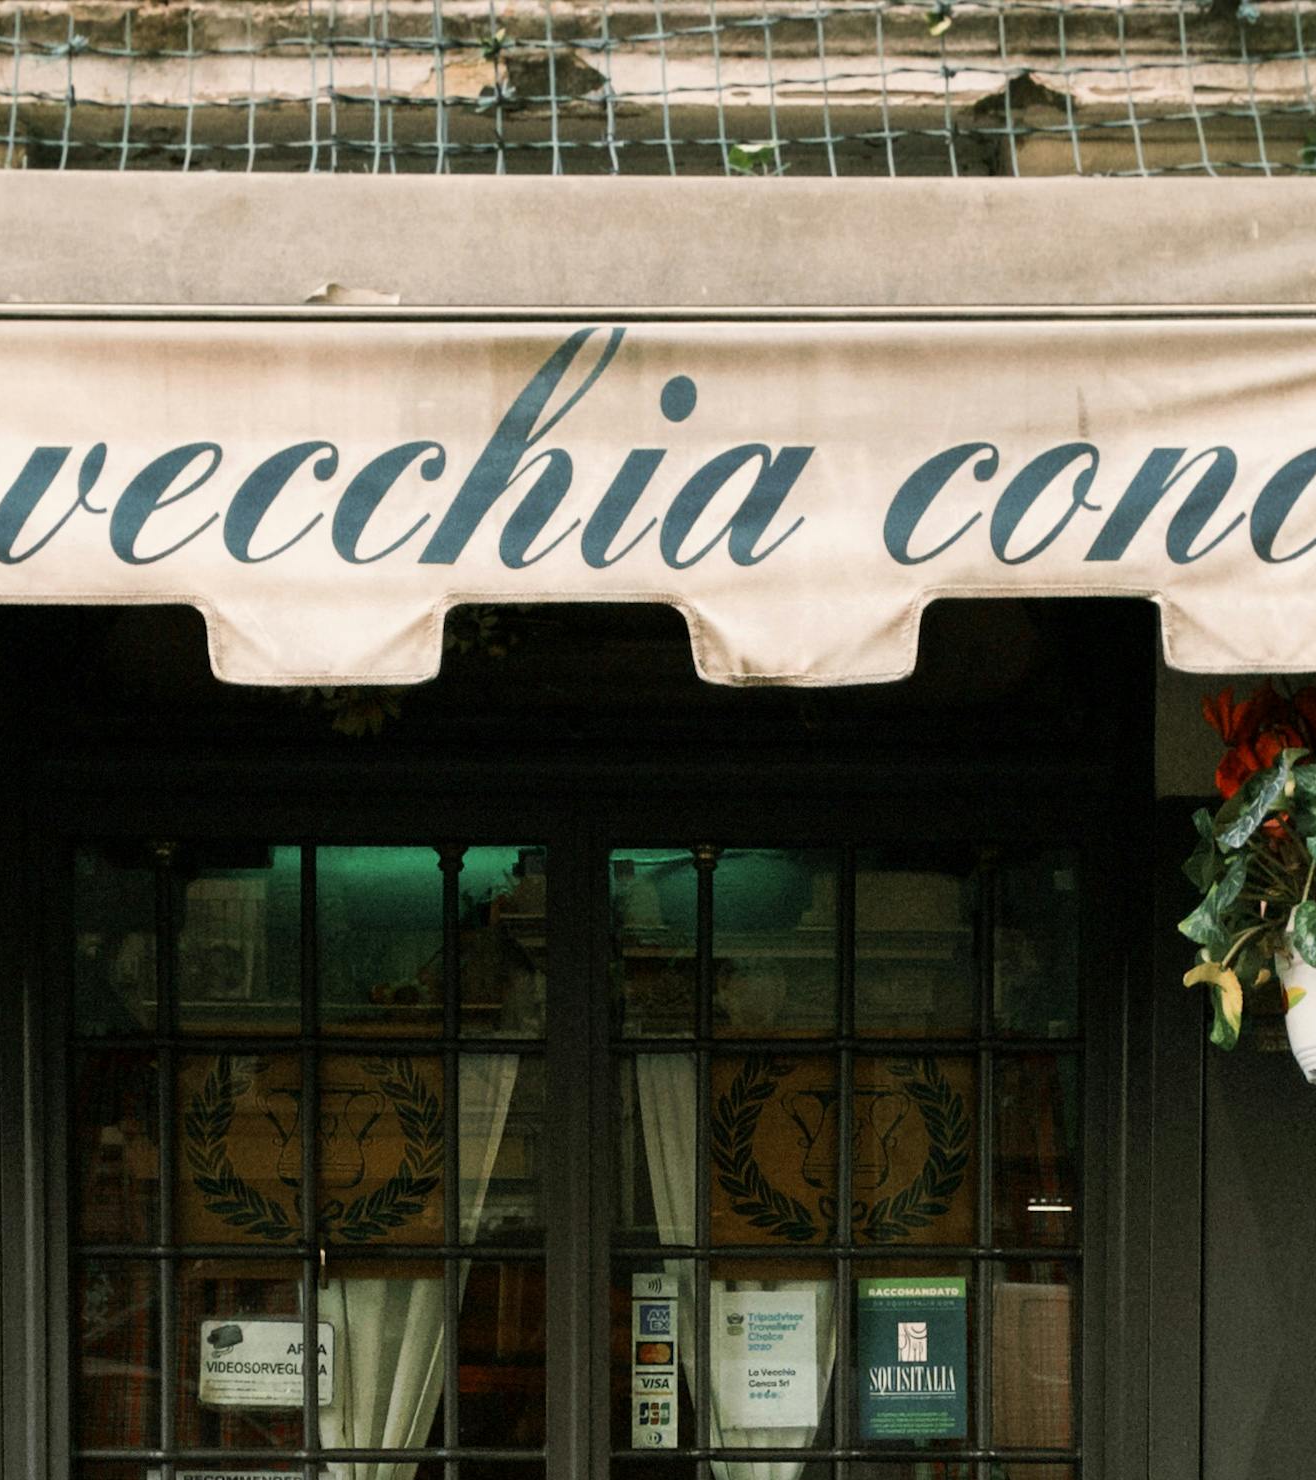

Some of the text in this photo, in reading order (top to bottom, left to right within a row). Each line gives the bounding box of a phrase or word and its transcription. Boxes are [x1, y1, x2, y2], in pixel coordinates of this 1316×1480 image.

[868, 1287, 960, 1297] RACCOMANDATO
[747, 1311, 805, 1323] Tripadvisor
[747, 1331, 784, 1342] Choice
[287, 1343, 328, 1356] ARA
[206, 1360, 328, 1376] VIDEOSORVEGLA
[748, 1368, 797, 1377] La Vecchia
[641, 1378, 670, 1389] VISA
[748, 1379, 777, 1388] Conca
[868, 1365, 956, 1395] SQUISITALIA
